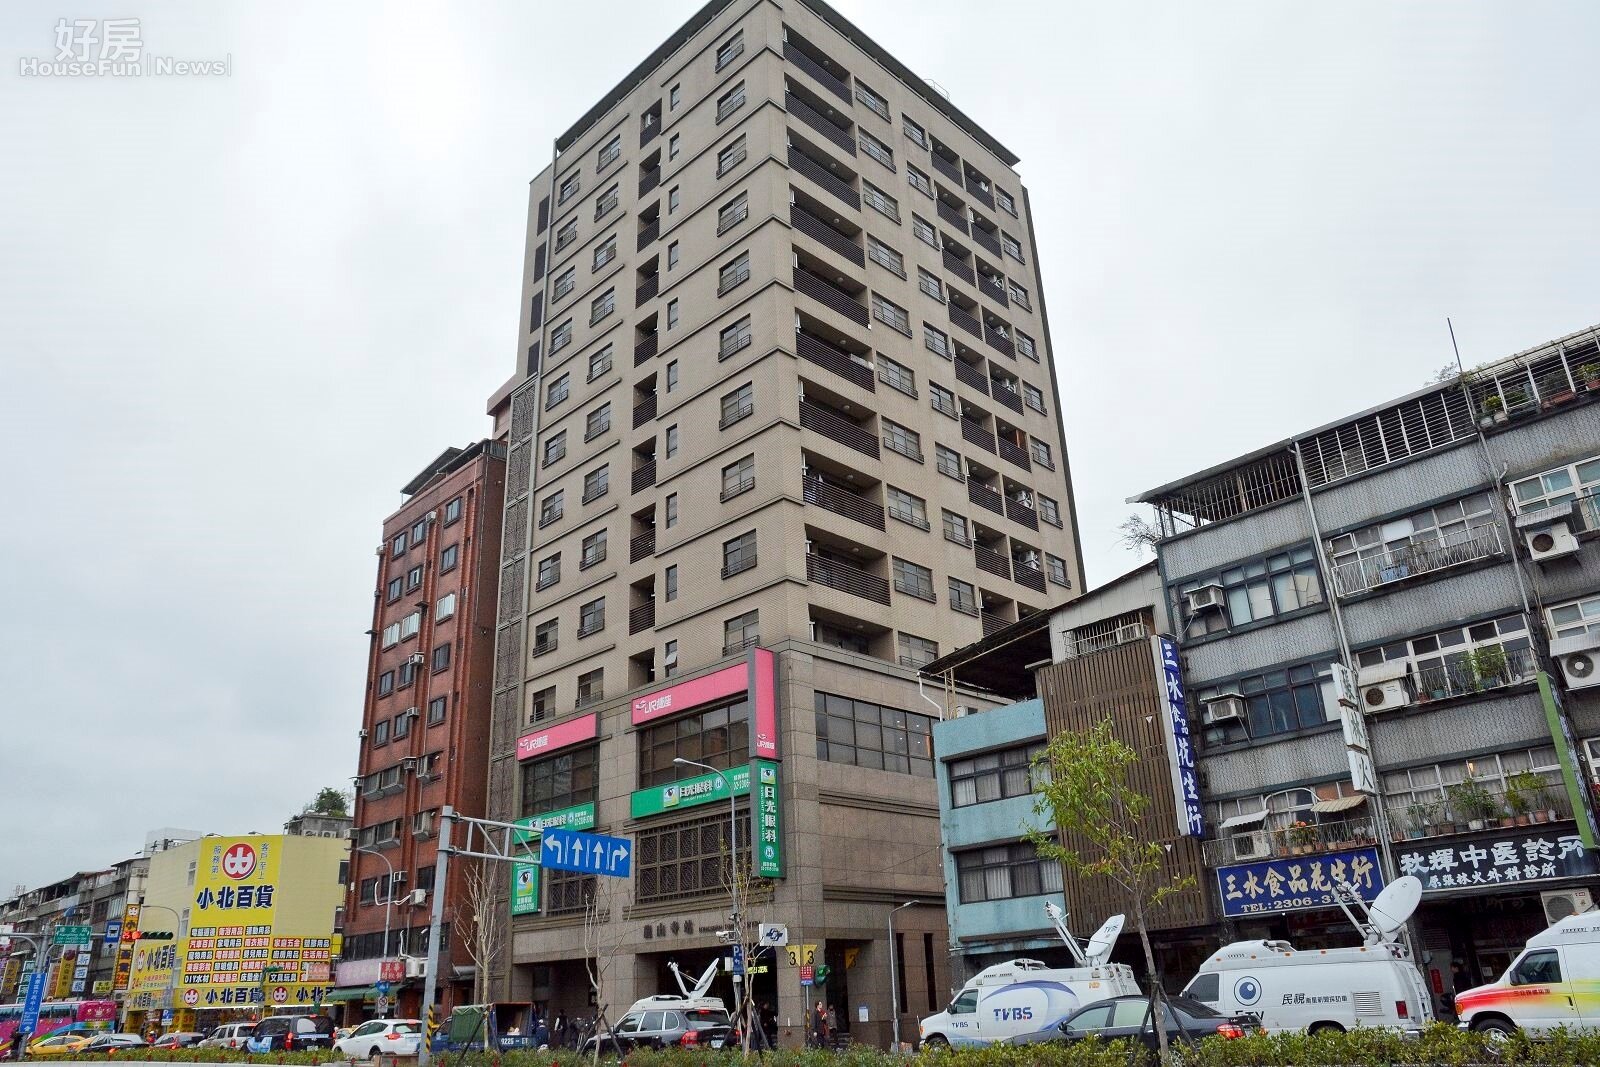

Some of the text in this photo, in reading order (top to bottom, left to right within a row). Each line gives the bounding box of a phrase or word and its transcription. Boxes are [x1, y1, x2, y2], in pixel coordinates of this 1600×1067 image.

[1163, 642, 1202, 835] 三水食品花生行
[680, 778, 713, 798] 日光眼科
[765, 785, 776, 843] 日光眼科
[1225, 855, 1374, 900] 三水食品花生行
[196, 885, 275, 910] 小北百貨
[147, 944, 176, 971] 小北百貨
[789, 951, 797, 966] 3
[807, 950, 815, 965] 3
[206, 987, 263, 1005] 小北百貨
[1282, 993, 1305, 1005] 民視
[993, 1006, 1033, 1021] TVBS
